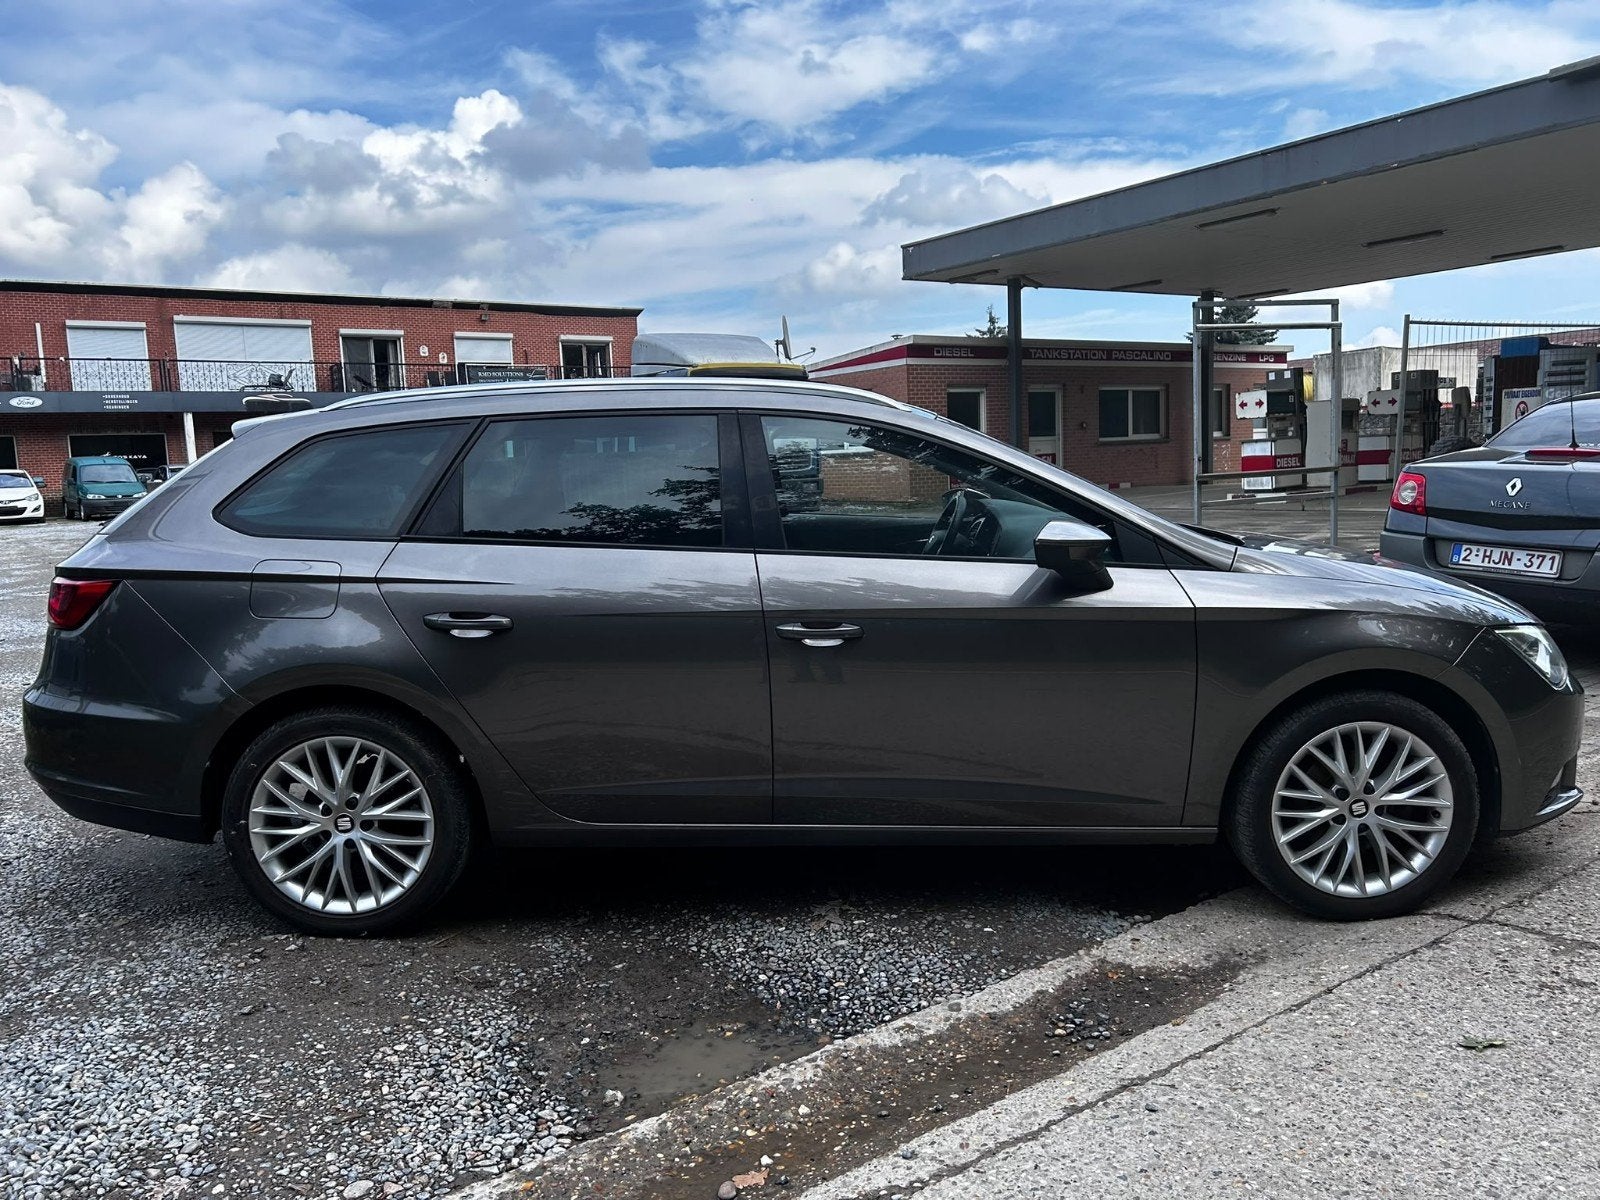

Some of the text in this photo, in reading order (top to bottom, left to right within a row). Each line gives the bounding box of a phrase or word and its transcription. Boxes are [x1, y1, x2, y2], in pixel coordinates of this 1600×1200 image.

[933, 348, 974, 357] DIESEL
[1029, 349, 1171, 361] TANKSTATION PASCALINO
[1259, 354, 1274, 362] LPG
[1276, 457, 1301, 468] DIESEL
[1489, 500, 1532, 509] MEGANE
